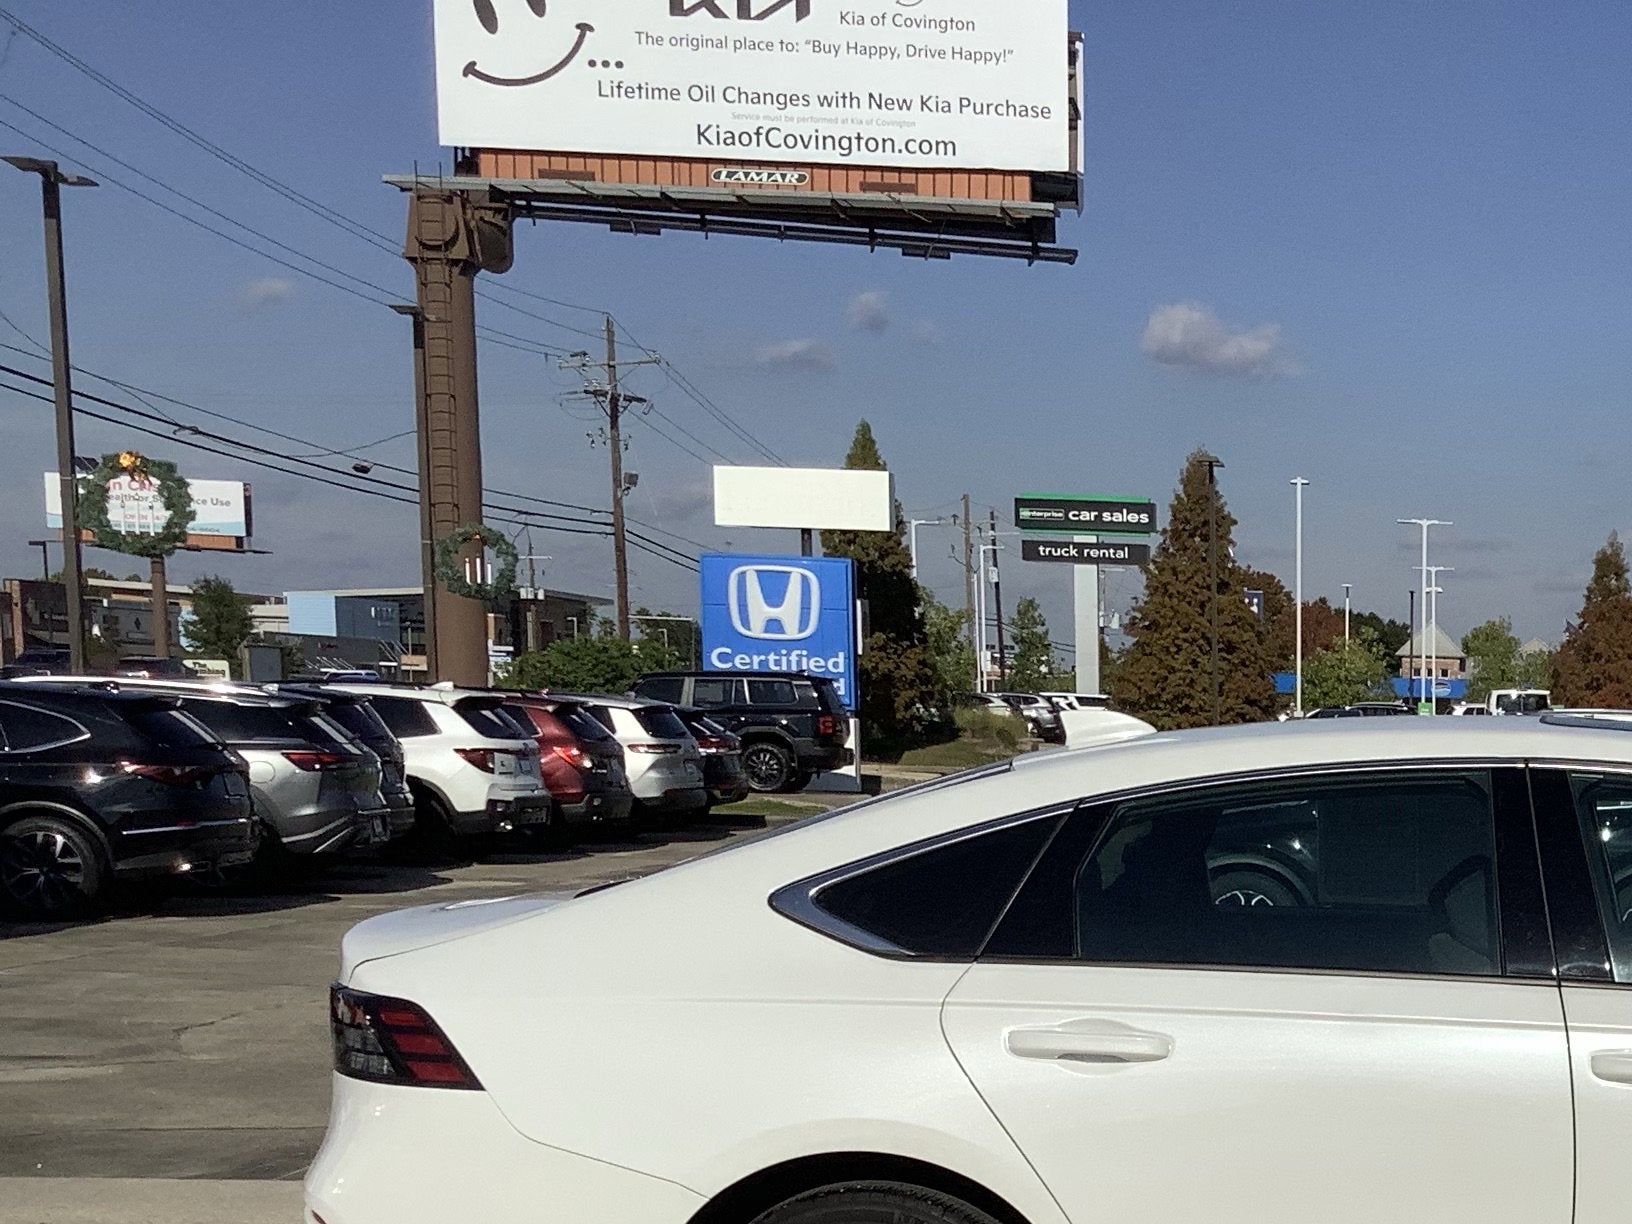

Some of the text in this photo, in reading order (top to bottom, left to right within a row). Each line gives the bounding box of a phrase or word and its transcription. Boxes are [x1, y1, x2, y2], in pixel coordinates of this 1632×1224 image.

[839, 11, 976, 34] Kia of Covington
[634, 31, 664, 46] The
[668, 33, 728, 51] original
[733, 37, 774, 52] place
[779, 38, 800, 53] to:
[846, 41, 901, 61] Happy,
[905, 43, 946, 60] Drive
[597, 80, 1052, 120] Lifetime Oil Changes with New Kia Purchase
[731, 111, 760, 121] Service
[762, 113, 783, 123] must
[796, 116, 839, 127] performed
[876, 118, 917, 129] Covington
[696, 124, 957, 157] KiaofCovington.com
[719, 170, 800, 184] LAMAR
[110, 493, 134, 502] ealth
[211, 497, 231, 507] Use
[1068, 510, 1098, 521] car
[1102, 508, 1149, 523] sales
[1038, 544, 1129, 559] truck rental
[710, 646, 845, 673] Certified
